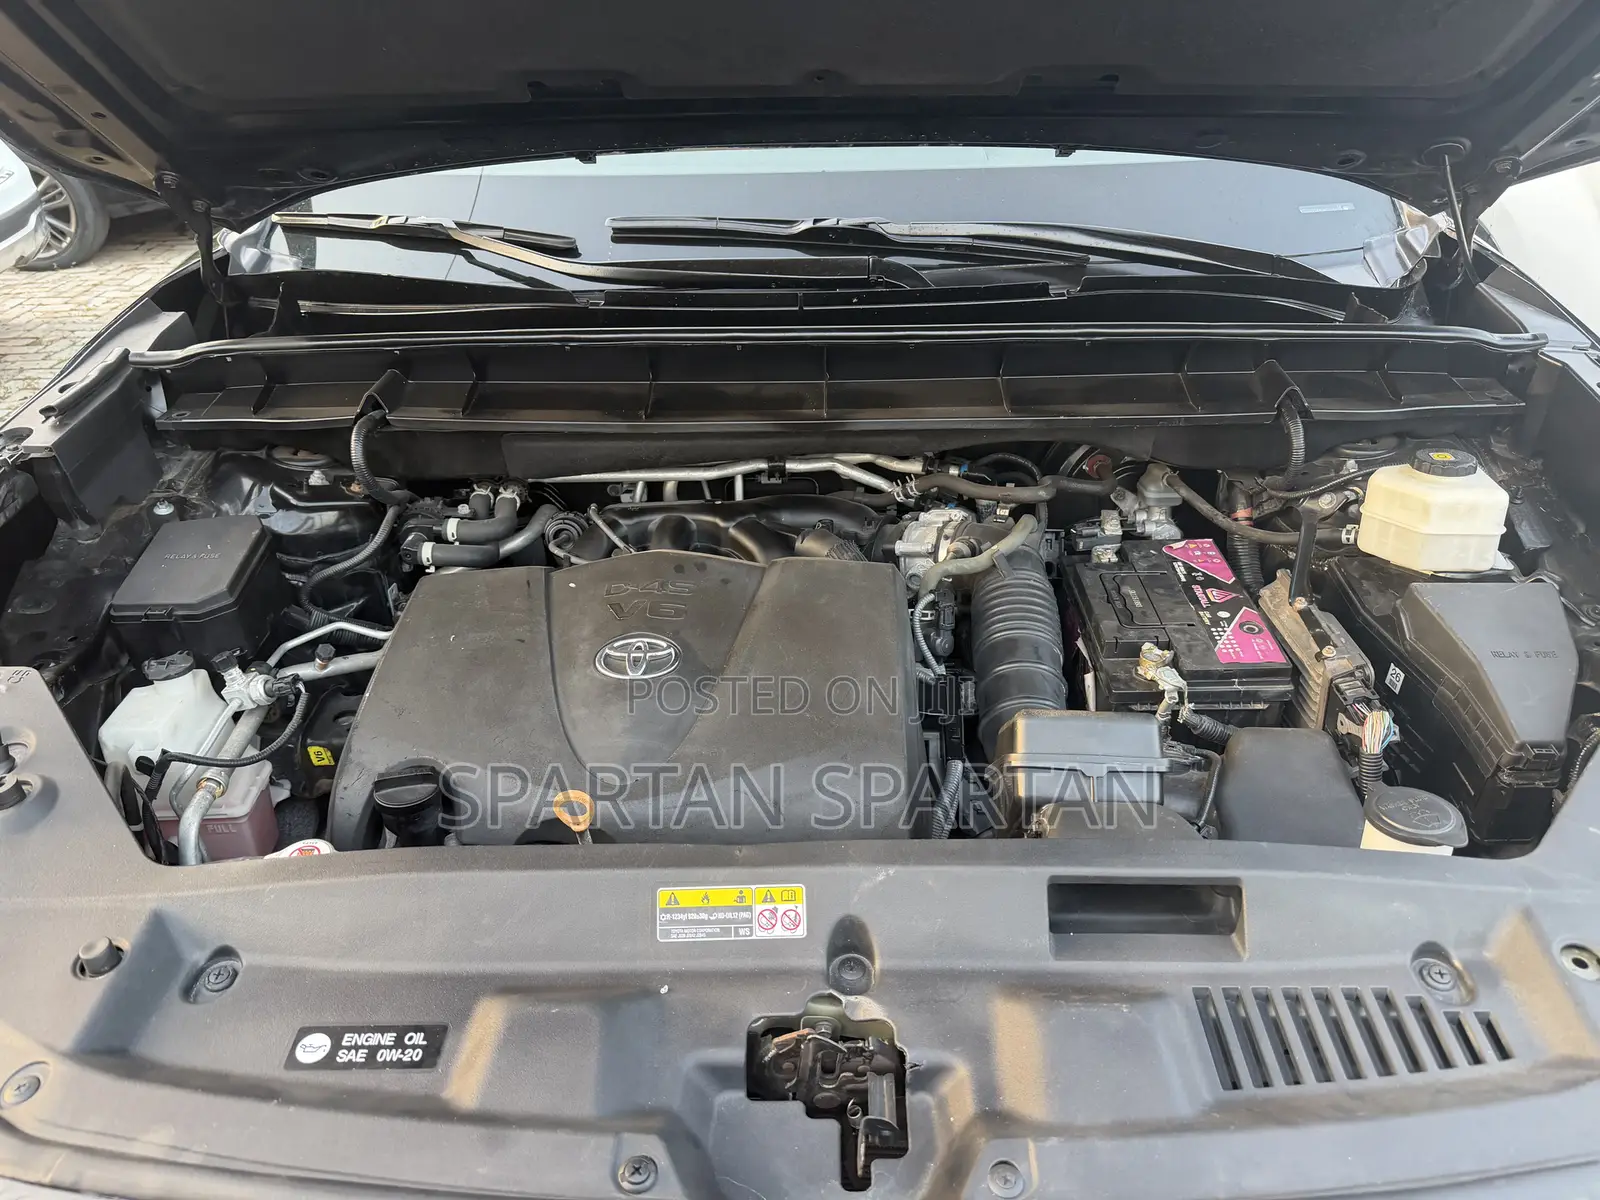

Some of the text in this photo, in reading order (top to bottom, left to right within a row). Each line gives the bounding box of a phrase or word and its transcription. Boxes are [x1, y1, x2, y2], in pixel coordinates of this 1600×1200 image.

[164, 552, 191, 560] RELAY
[199, 552, 221, 560] FUSE
[607, 599, 688, 619] V6
[1490, 650, 1520, 659] RELAY
[1533, 650, 1558, 659] FUSE
[1390, 668, 1401, 682] 26
[314, 750, 325, 762] V6
[206, 824, 237, 833] FULL
[738, 928, 750, 936] WS
[341, 1032, 427, 1046] ENGINE OIL
[335, 1048, 423, 1062] SAE 0W-20
